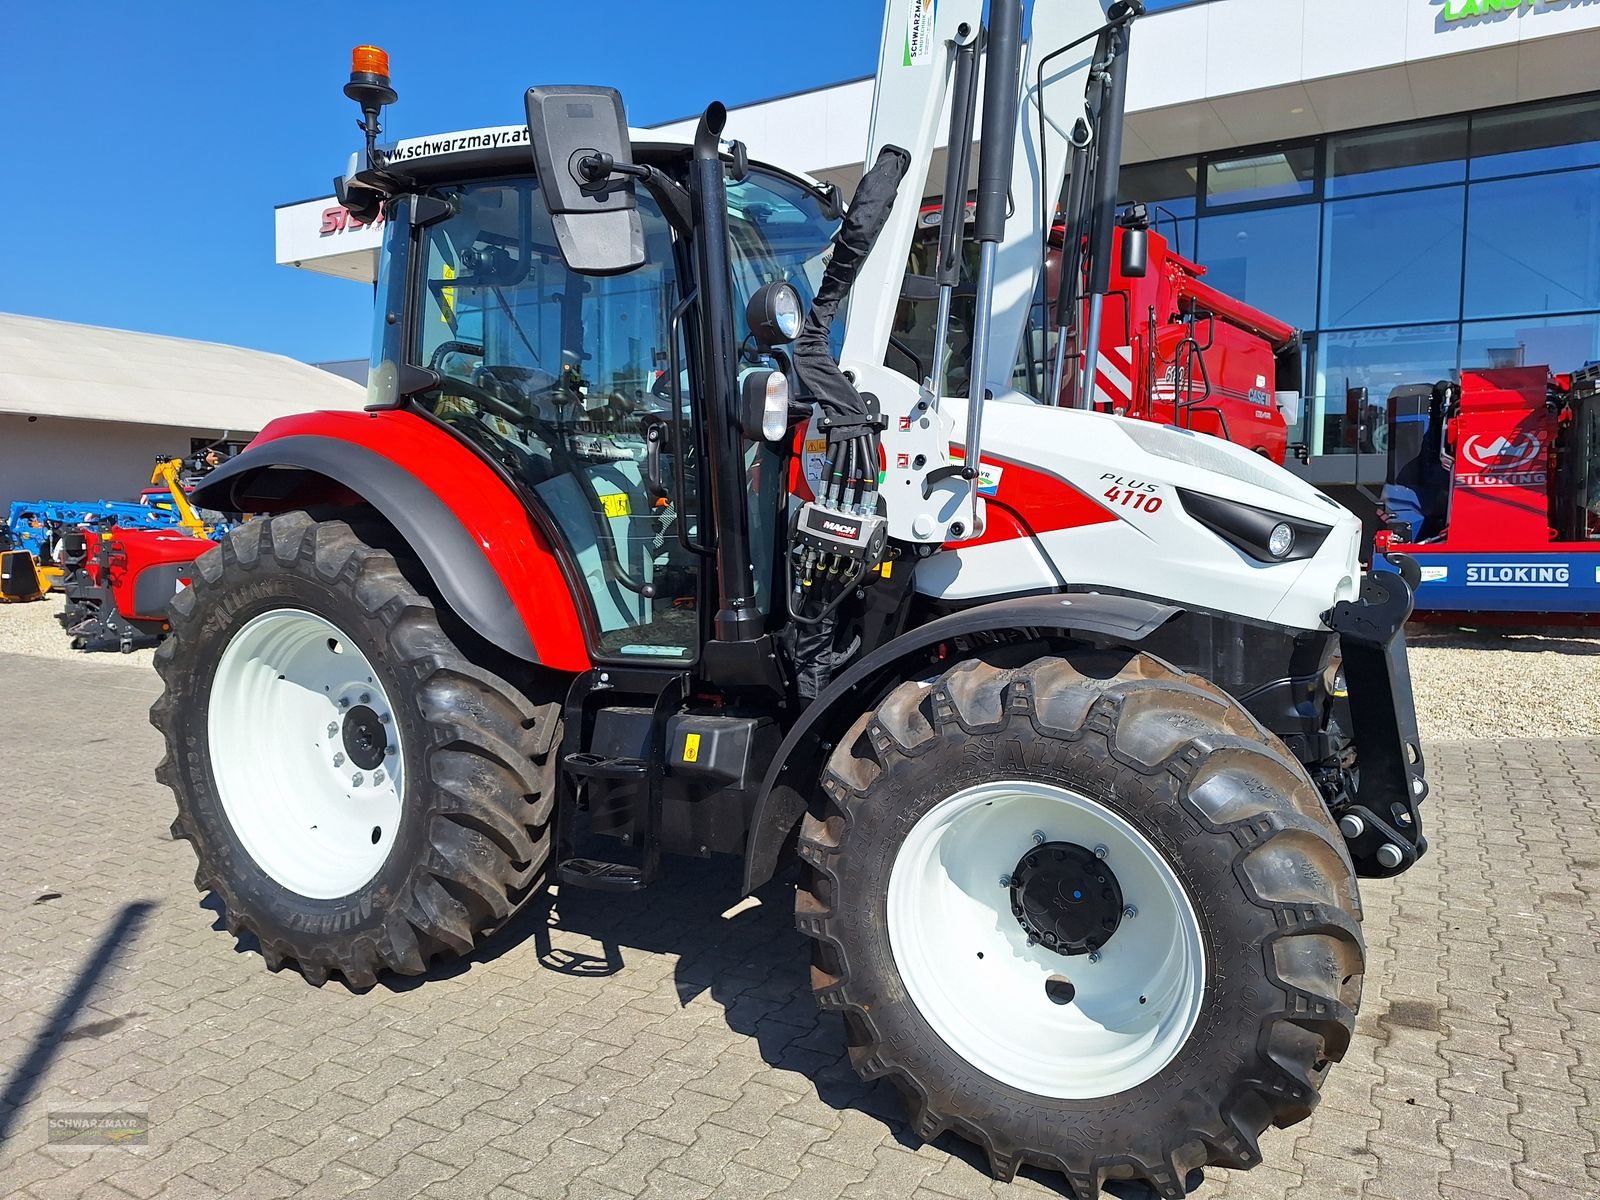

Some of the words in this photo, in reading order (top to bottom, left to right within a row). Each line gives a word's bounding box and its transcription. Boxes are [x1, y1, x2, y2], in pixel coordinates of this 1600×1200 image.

[1165, 366, 1185, 382] 610
[1099, 473, 1160, 493] PLUS
[1455, 474, 1546, 485] SILOKING
[1103, 486, 1163, 513] 4110
[823, 520, 857, 535] MACH
[1466, 567, 1569, 582] SILOKING
